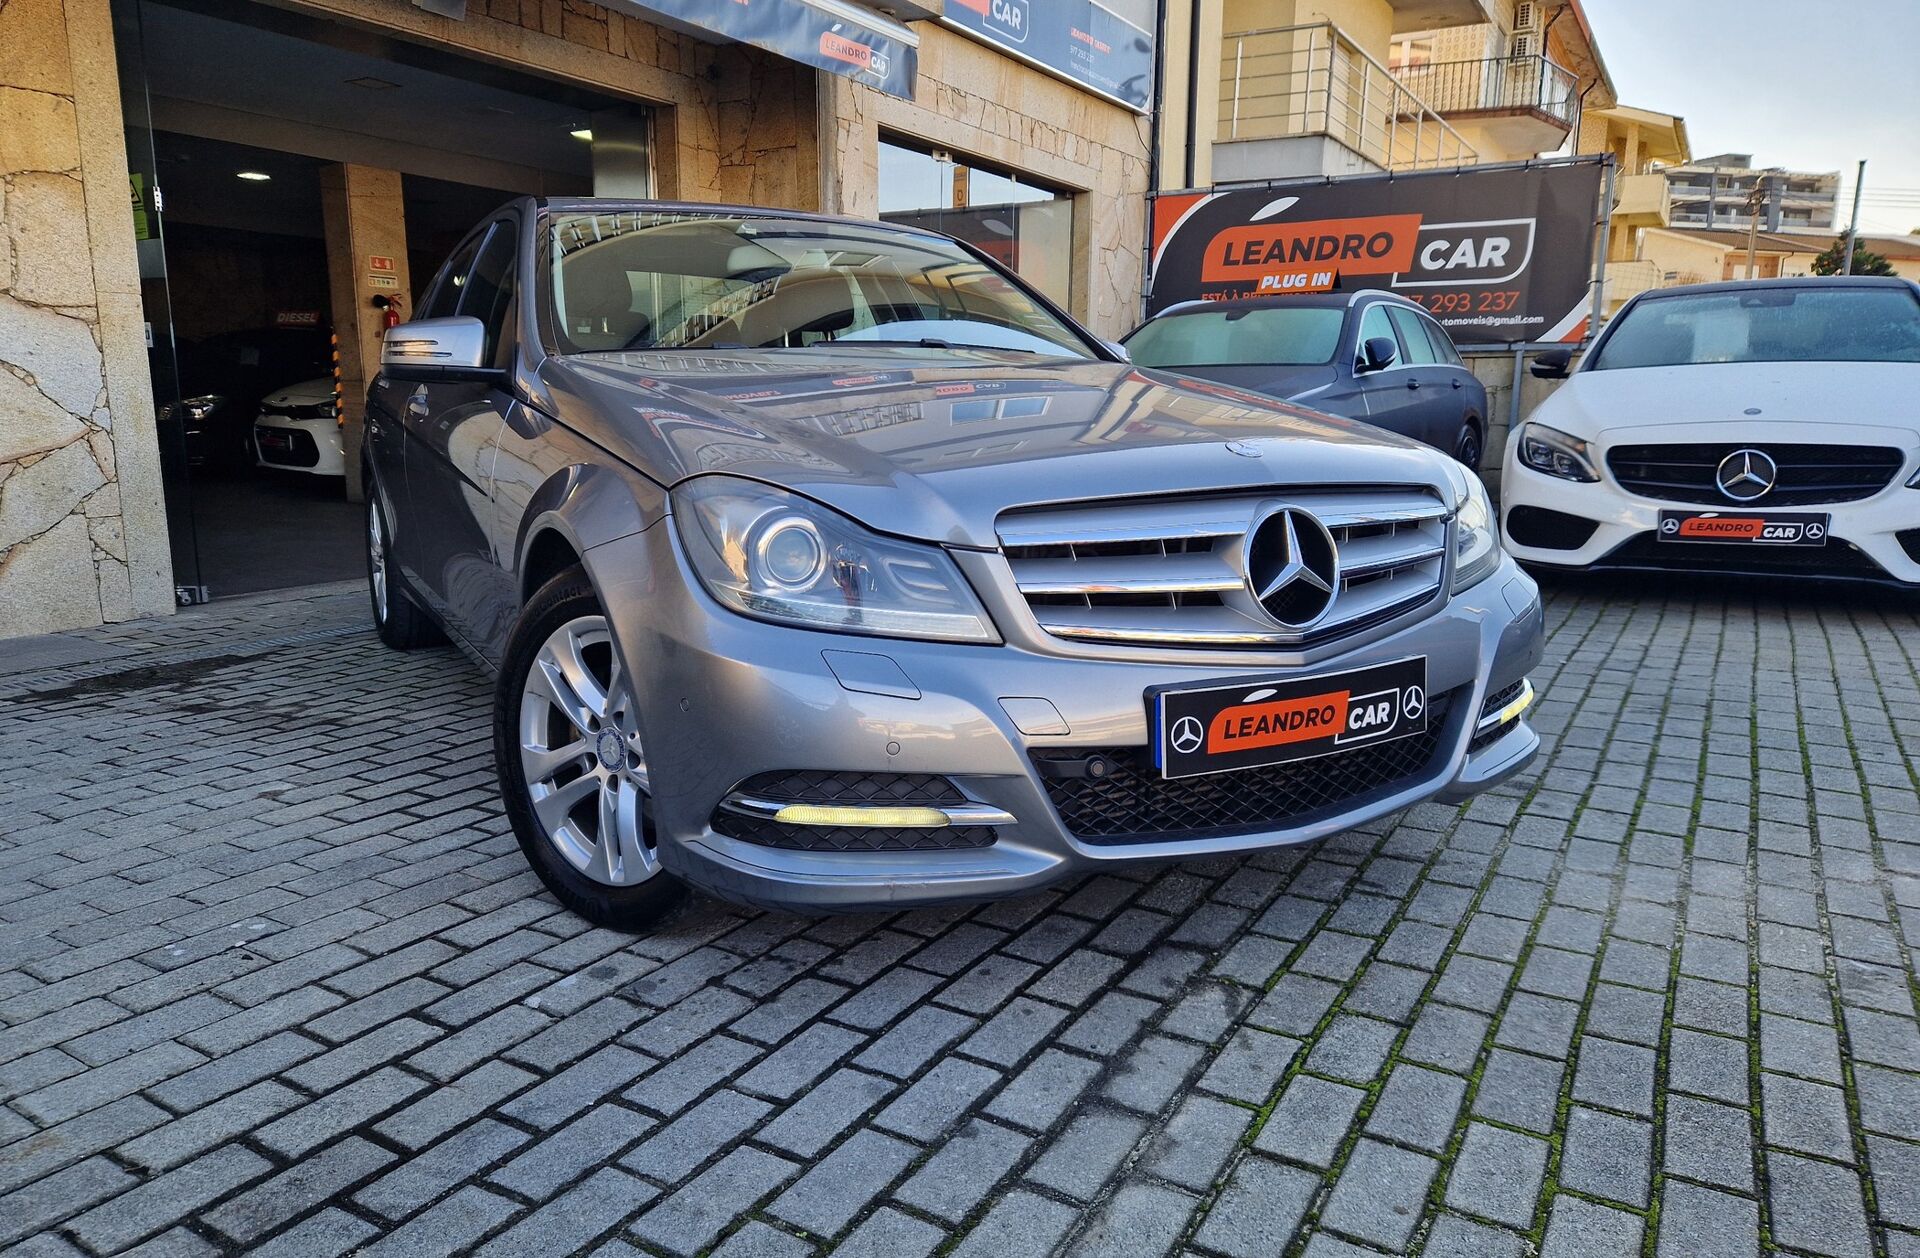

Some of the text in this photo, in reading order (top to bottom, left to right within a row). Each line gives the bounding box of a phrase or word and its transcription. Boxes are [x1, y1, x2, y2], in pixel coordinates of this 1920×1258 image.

[992, 0, 1021, 30] CAR
[825, 39, 886, 73] LEANDRO CAR
[1222, 231, 1511, 271] LEANDRO CAR
[1261, 272, 1332, 289] PLUG IN
[1430, 292, 1471, 313] 293
[1478, 291, 1521, 312] 237
[277, 312, 317, 322] DIESEL
[1688, 522, 1796, 538] LEANDRO CAR
[1223, 701, 1391, 740] LEANDRO CAR
